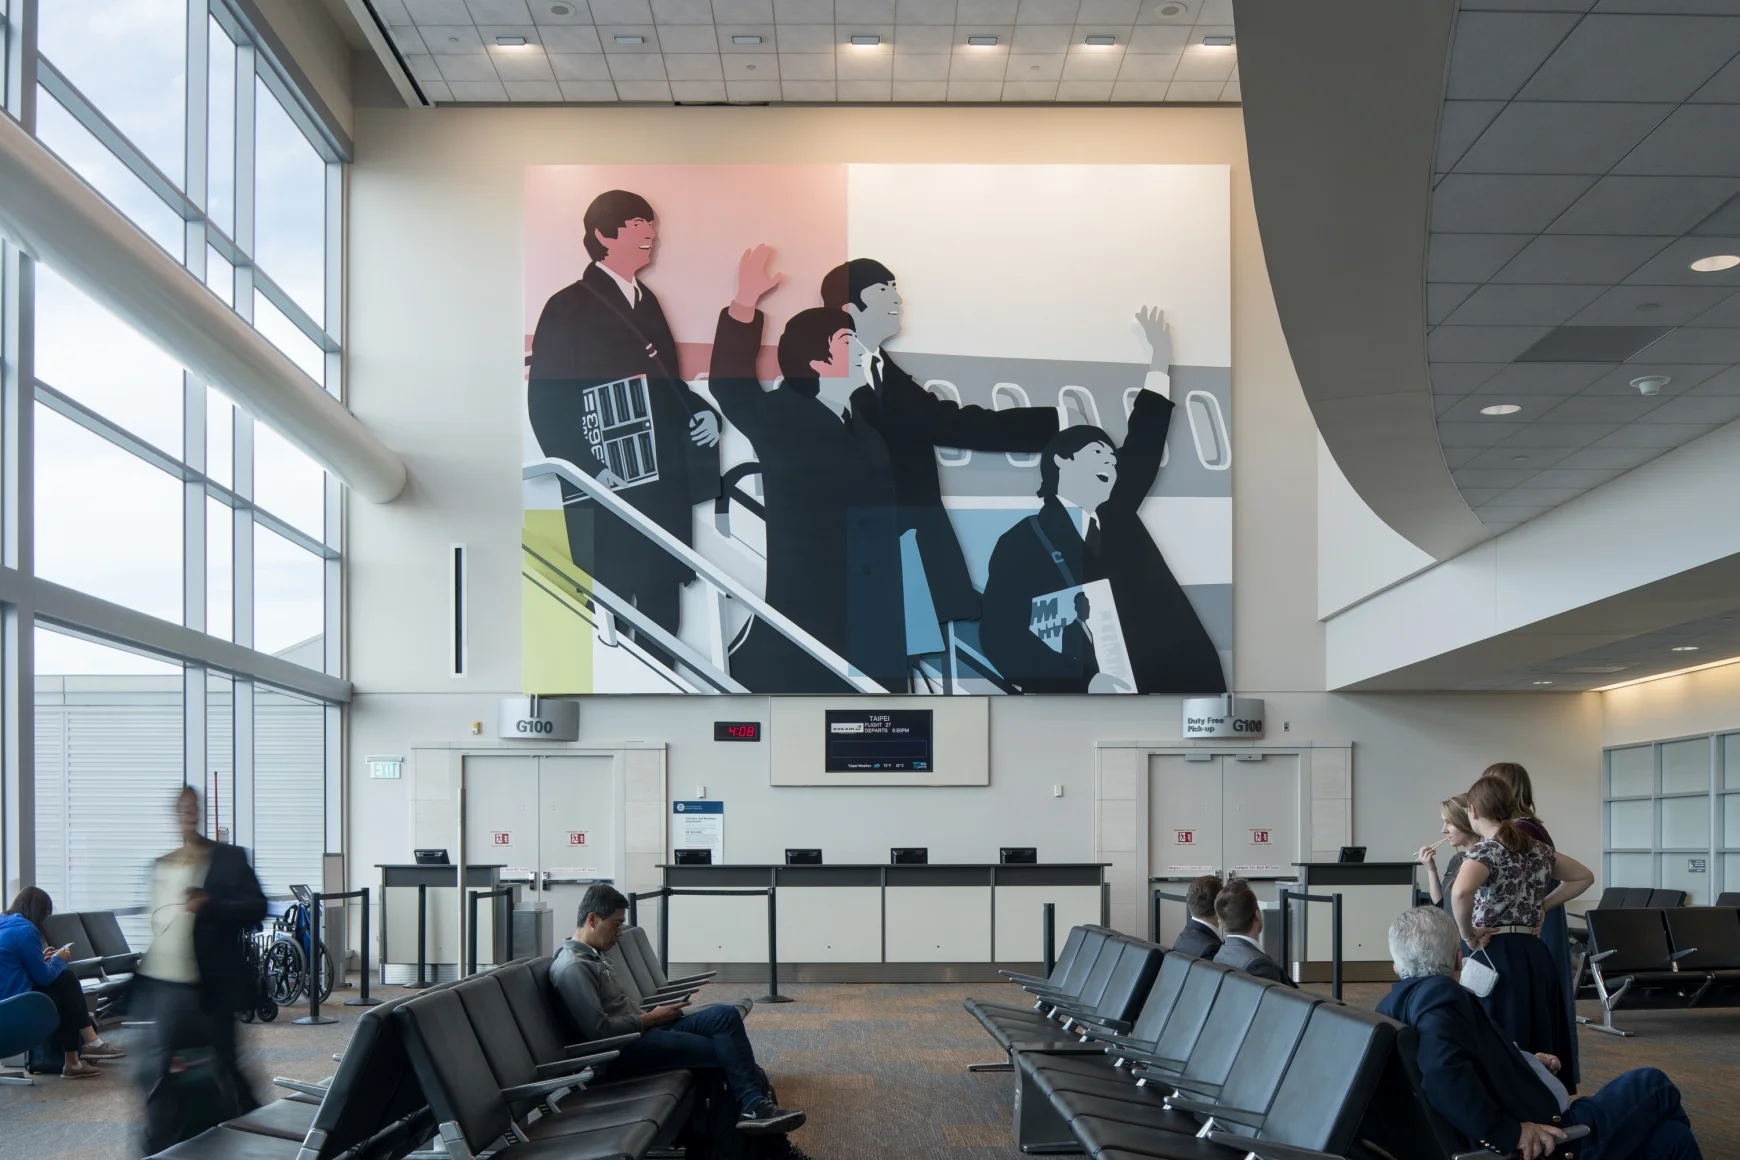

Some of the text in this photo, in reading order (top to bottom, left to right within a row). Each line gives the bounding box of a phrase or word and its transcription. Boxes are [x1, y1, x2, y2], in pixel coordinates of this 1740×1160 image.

[516, 720, 553, 733] G100
[1187, 717, 1205, 725] Duty
[1232, 719, 1262, 732] G100
[728, 726, 755, 737] 4:08
[1187, 725, 1215, 733] Pick-up
[373, 763, 397, 778] EXIT
